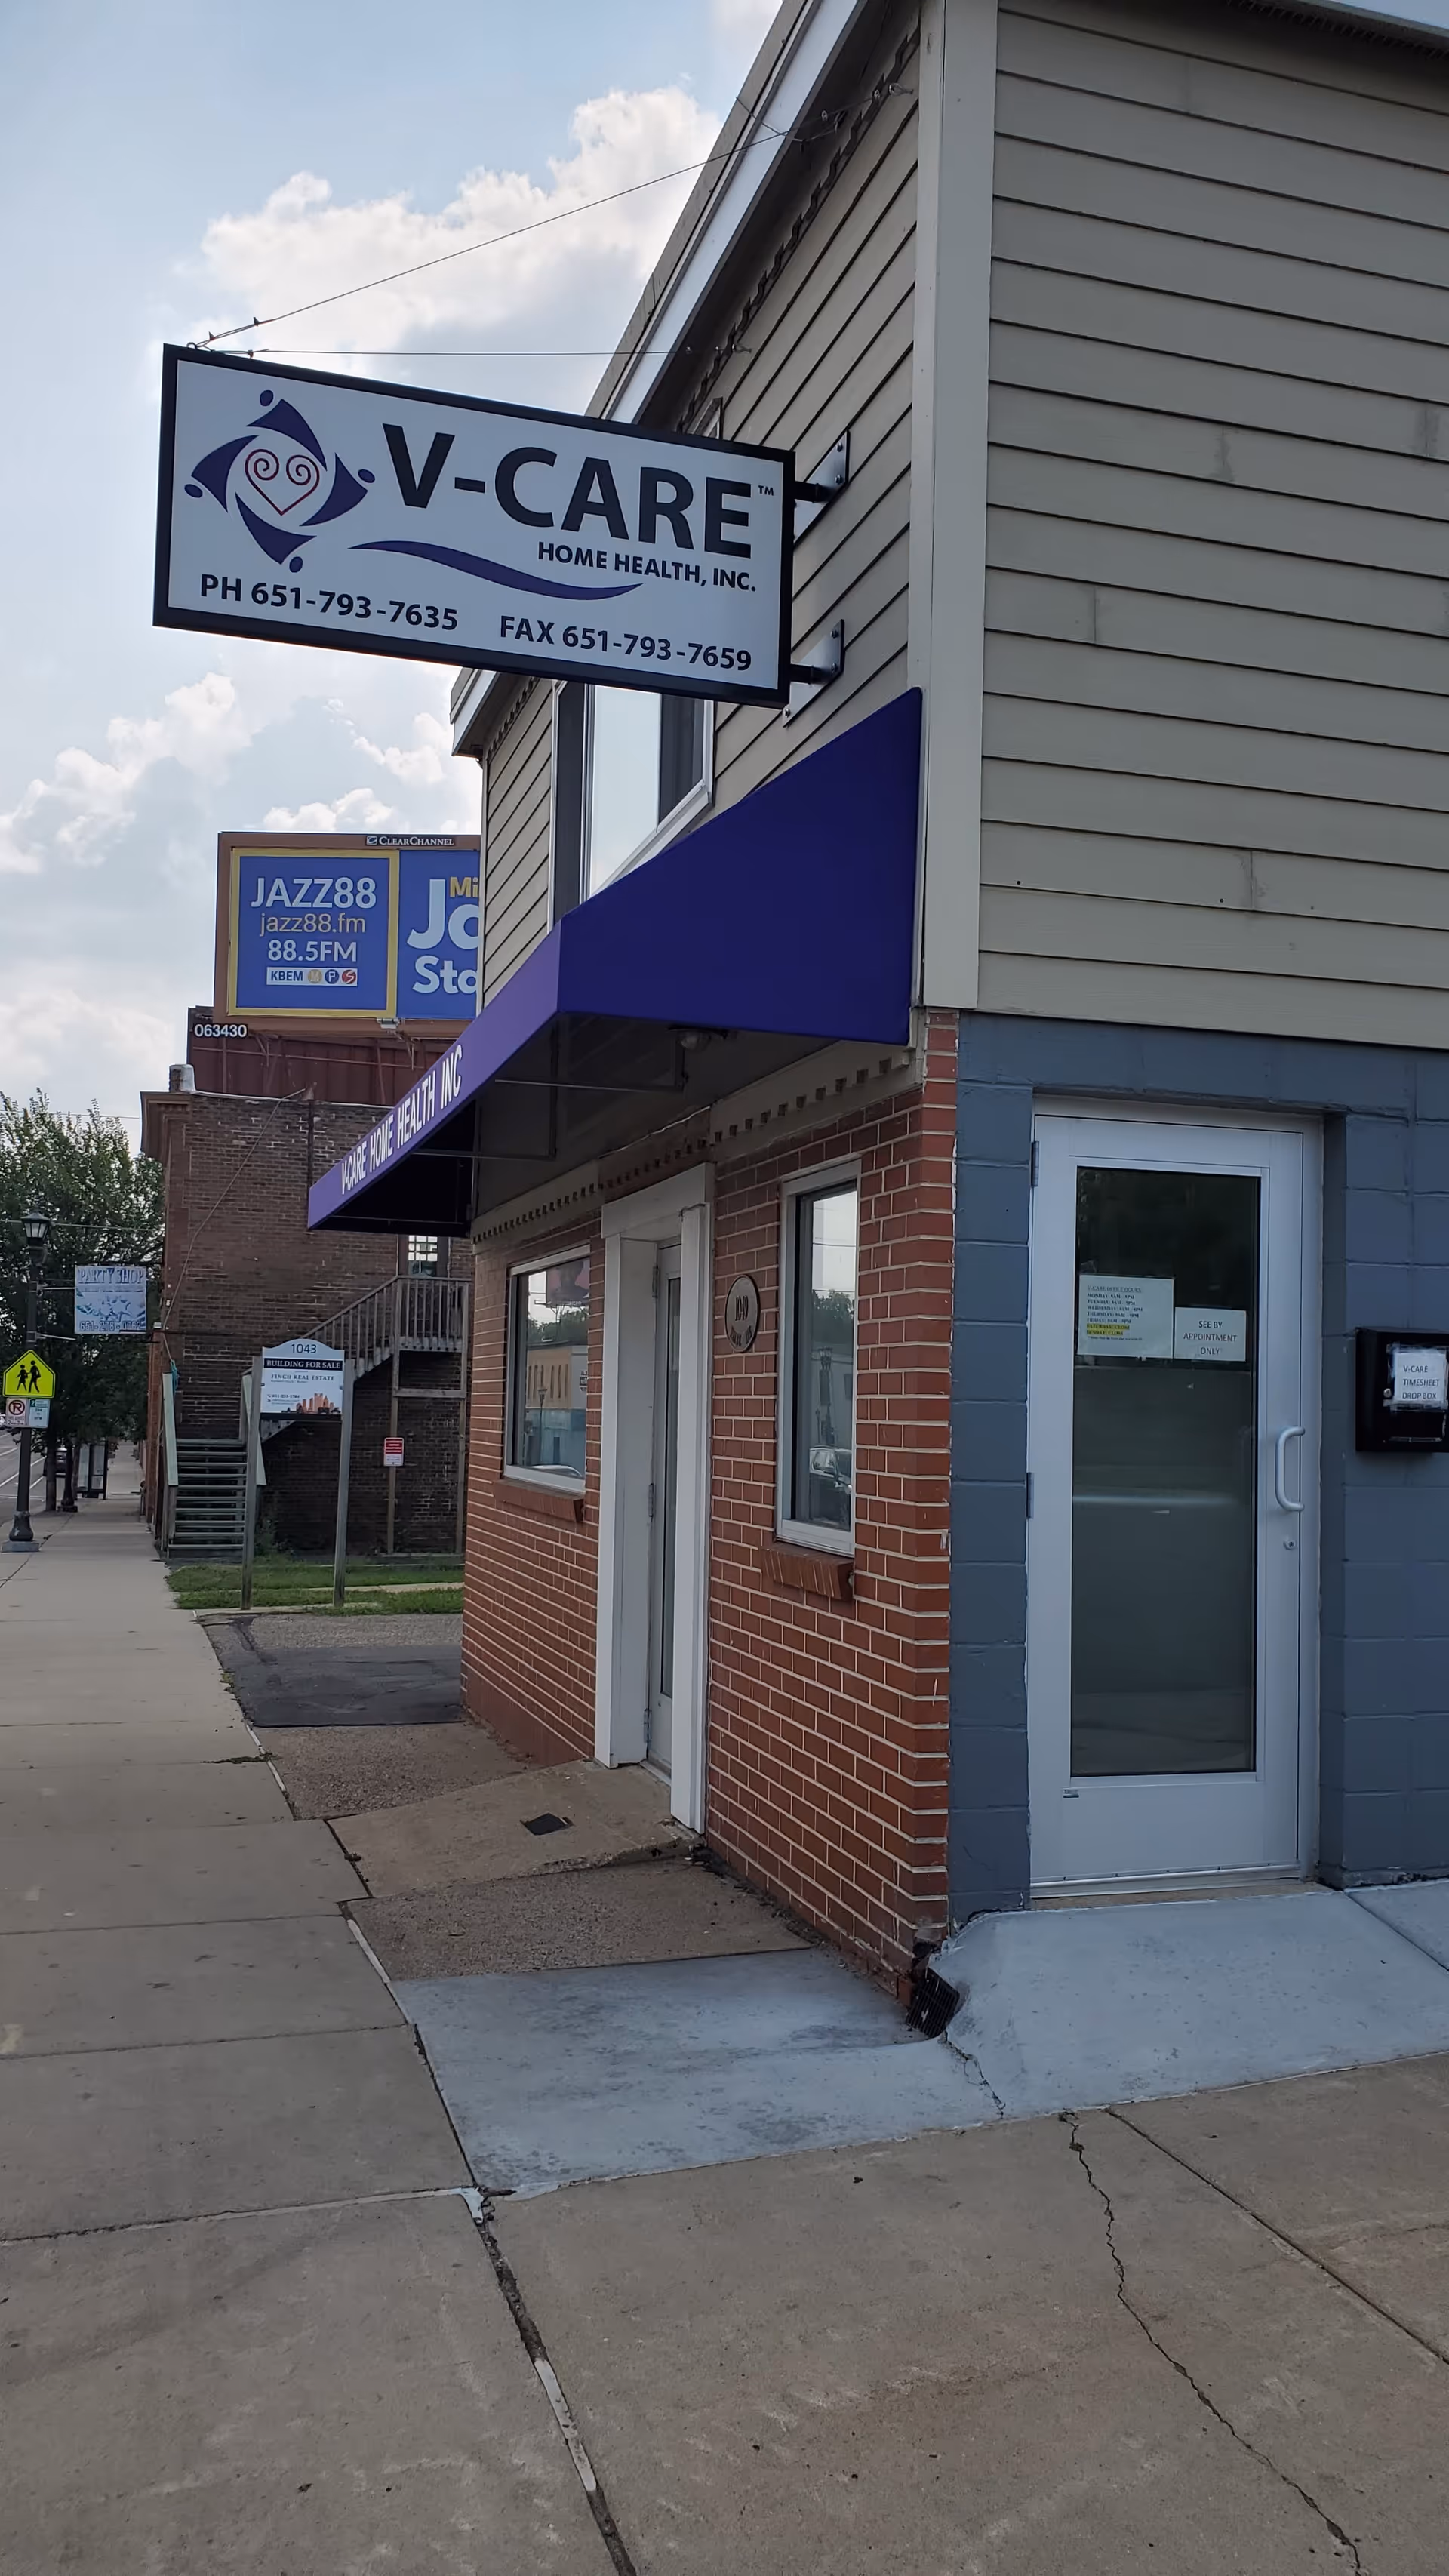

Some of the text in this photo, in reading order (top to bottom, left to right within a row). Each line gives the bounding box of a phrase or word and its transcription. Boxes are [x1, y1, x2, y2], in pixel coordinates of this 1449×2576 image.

[383, 423, 752, 559] V-CARE
[538, 541, 756, 592] HOME HEALTH, INC.
[200, 574, 458, 631] PH 651-793-7635
[500, 614, 752, 671] FAX 651-793-7659
[251, 876, 377, 909] JAZZ88
[259, 912, 366, 937] jazz88.fm
[268, 939, 357, 962] 88.5FM
[271, 970, 303, 981] KBEM
[194, 1023, 248, 1038] 063430
[341, 1044, 463, 1196] V-CARE HOME HEALTH INC
[78, 1268, 144, 1284] PARTY SHOP
[1198, 1320, 1223, 1329] SEE BY
[1183, 1332, 1238, 1342] APPOINTMENT
[291, 1343, 317, 1354] 1043
[1200, 1346, 1220, 1356] ONLY
[266, 1359, 304, 1368] BUILDING
[1403, 1365, 1429, 1373] V-CARE
[1402, 1378, 1441, 1387] TIMESHEET
